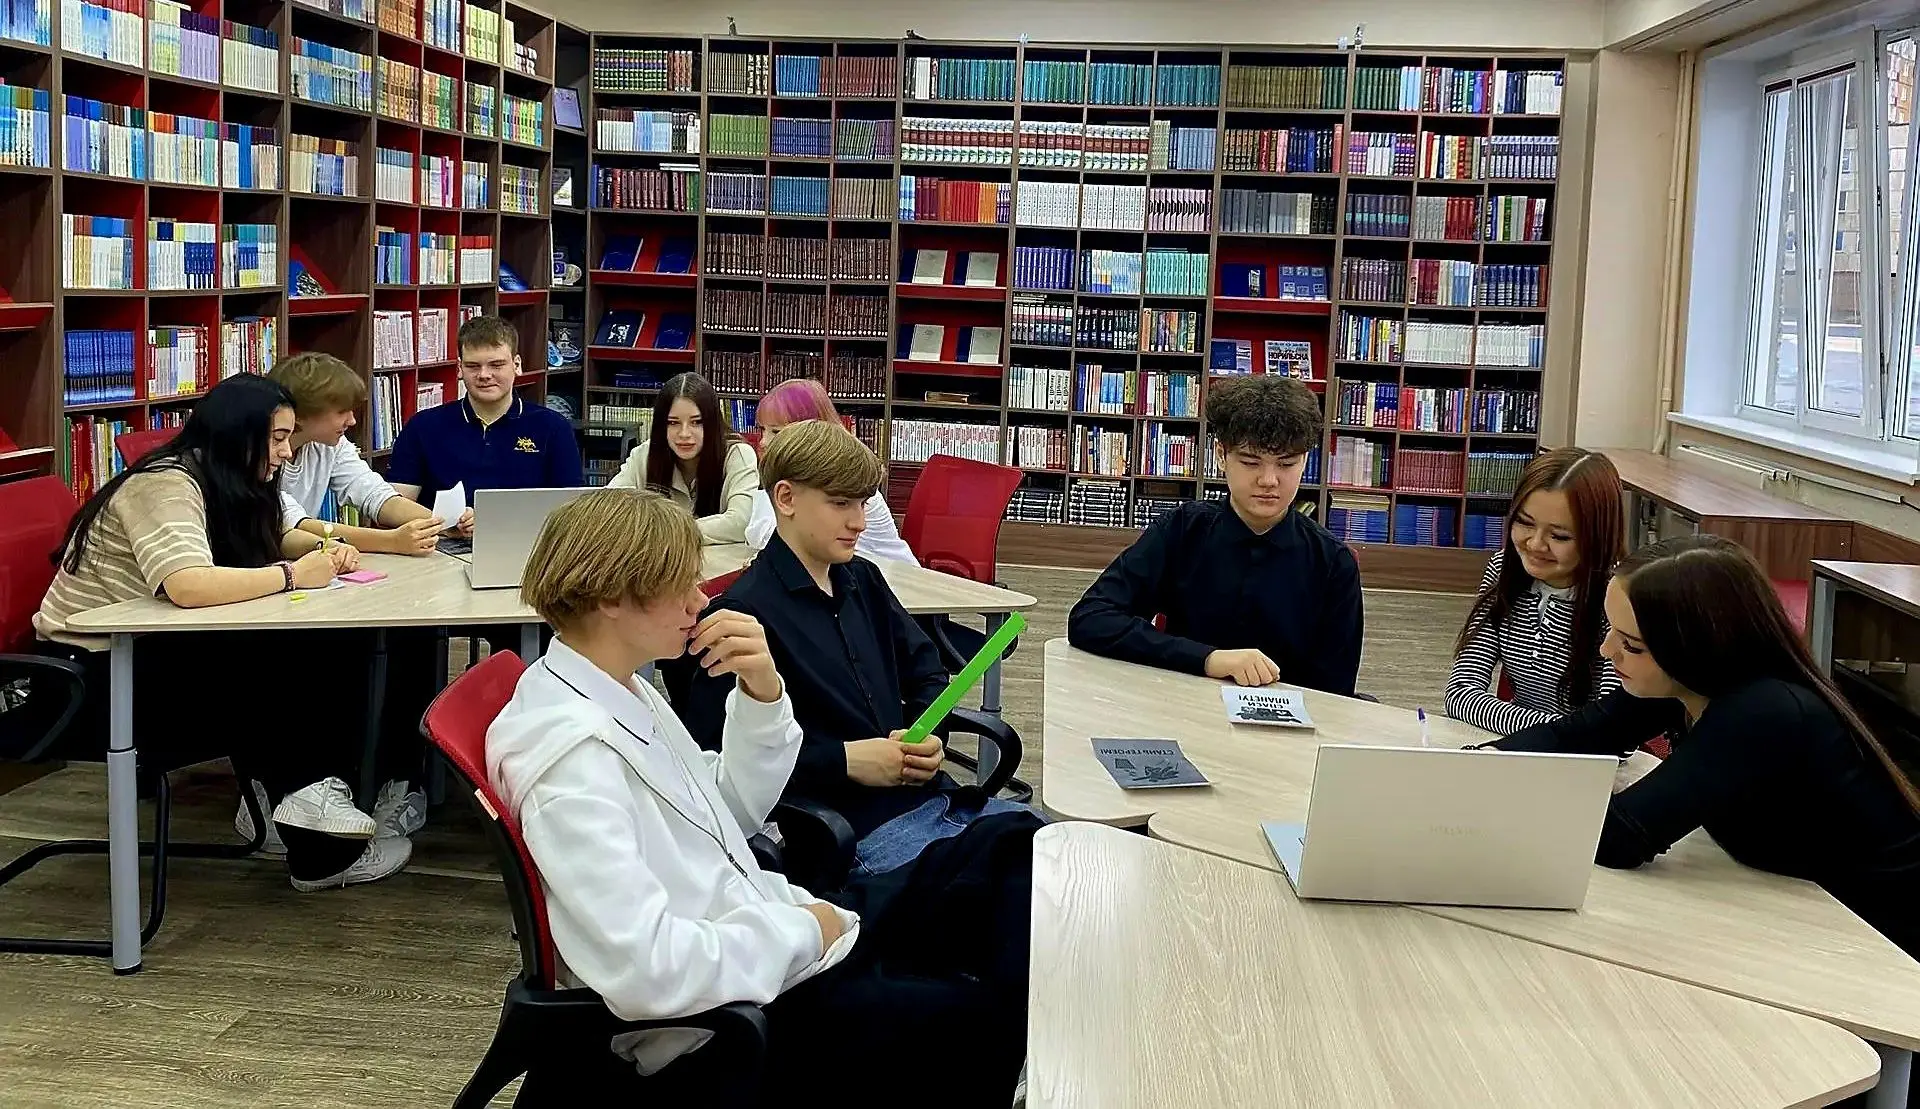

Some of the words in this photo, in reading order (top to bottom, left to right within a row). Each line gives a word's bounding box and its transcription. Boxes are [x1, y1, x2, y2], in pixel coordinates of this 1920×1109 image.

[1268, 351, 1309, 361] НОРИЛЬСКА
[1238, 694, 1290, 705] ПЛАНЕТУ!
[1247, 701, 1284, 709] СПАСИ
[1142, 748, 1174, 756] СТАНЬ
